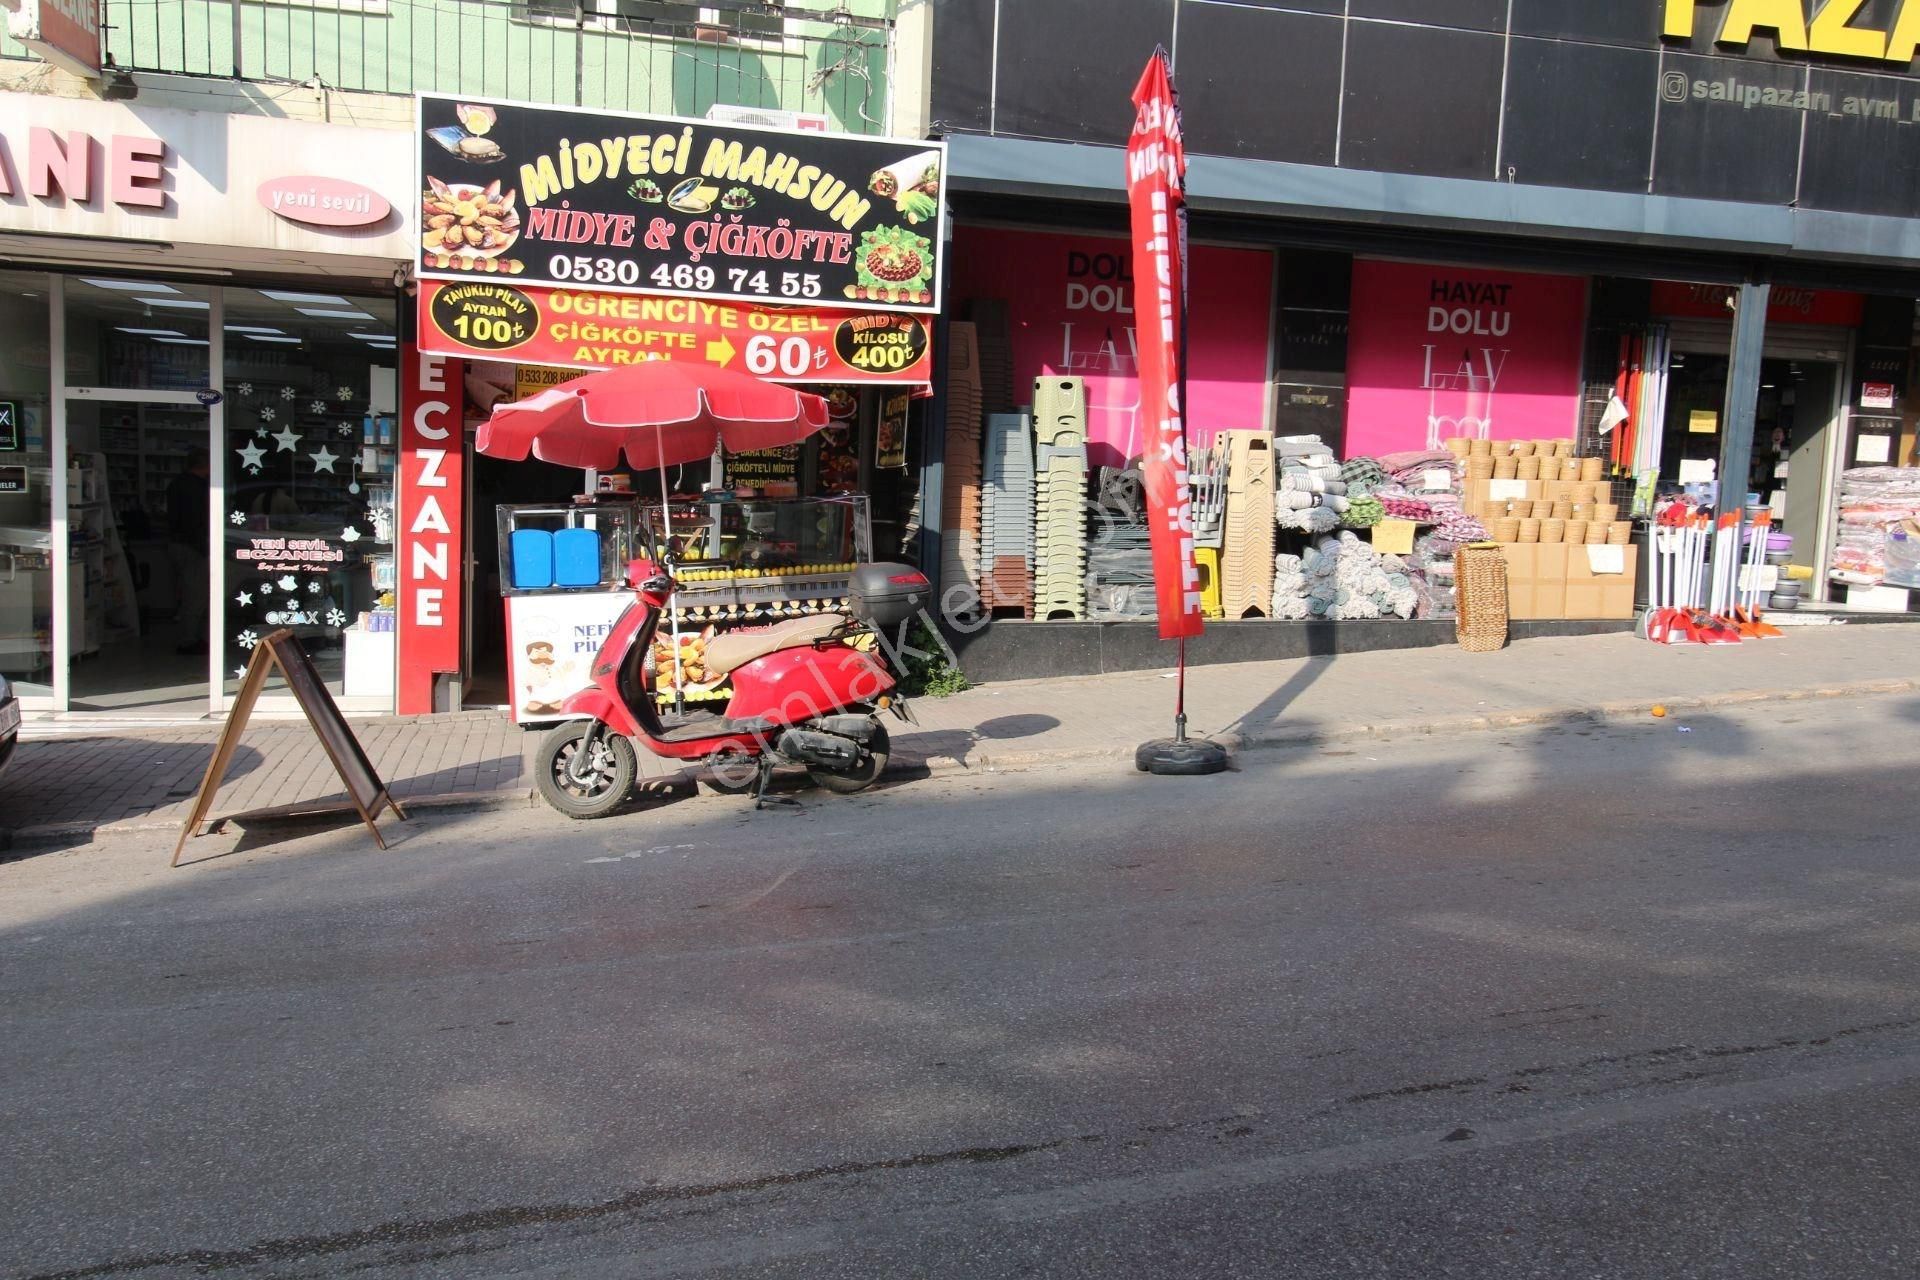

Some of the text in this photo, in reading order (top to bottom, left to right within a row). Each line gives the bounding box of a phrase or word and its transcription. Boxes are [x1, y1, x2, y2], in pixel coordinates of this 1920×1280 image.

[0, 127, 165, 208] NE
[519, 126, 871, 230] MİDYECİ MAHSUN
[272, 188, 371, 214] yeni sevil
[525, 200, 852, 264] MİDYE & ÇİĞKÖFTE
[549, 254, 821, 297] 0530 469 74 55
[1067, 252, 1133, 283] DOL
[443, 285, 527, 314] TAVUKLU PİLAV
[1066, 283, 1133, 313] DOL
[1430, 279, 1512, 306] HAYAT
[463, 303, 506, 317] AYRAN
[747, 305, 829, 332] ÖZEL
[1427, 306, 1510, 336] DOLU
[549, 321, 697, 348] ÇİĞKÖFTE
[853, 331, 909, 344] KİLOSU
[1419, 344, 1511, 391] LAV
[772, 462, 796, 473] MİDYE
[410, 352, 451, 627] ECZANE
[236, 549, 343, 562] ECZANESİ
[251, 538, 330, 551] YENİ SEVİL
[265, 611, 319, 625] ORZAX
[574, 620, 613, 637] NEFİ
[574, 637, 599, 653] PİL
